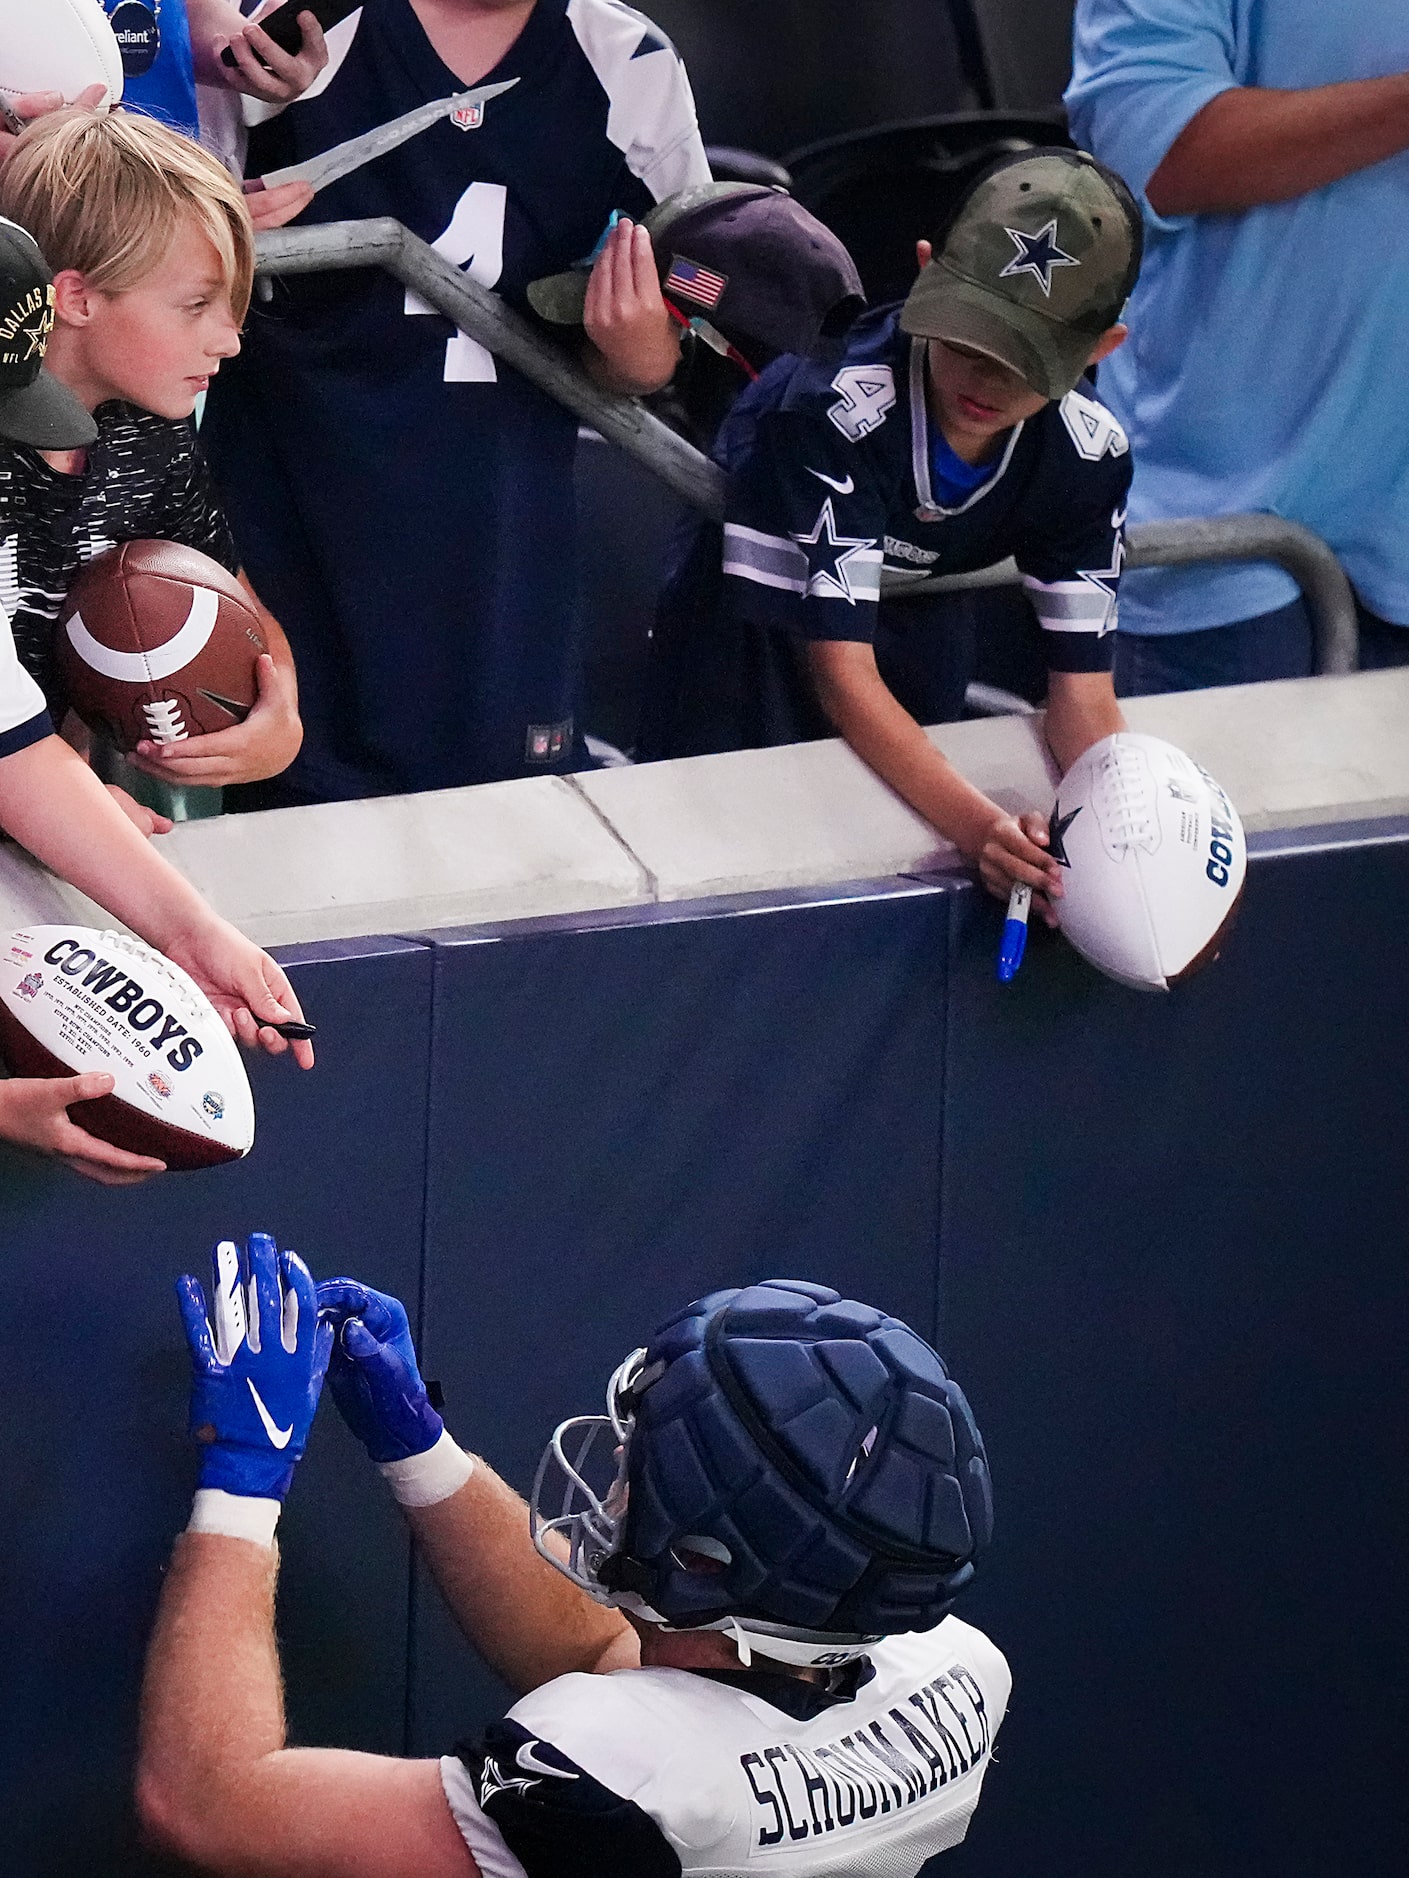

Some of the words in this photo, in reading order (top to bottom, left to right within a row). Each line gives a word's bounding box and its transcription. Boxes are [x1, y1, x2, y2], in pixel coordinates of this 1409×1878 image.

[827, 364, 896, 442] 4
[1059, 390, 1129, 461] 4
[43, 939, 204, 1072] COWBOYS
[53, 975, 107, 1016] ESTABLISHED
[106, 1016, 132, 1039] DATE:
[131, 1038, 151, 1057] 1960
[84, 1012, 112, 1037] CHAMPIONS
[82, 1032, 111, 1058] CHAMPIONS
[740, 1663, 991, 1846] SCHOONMAKER
